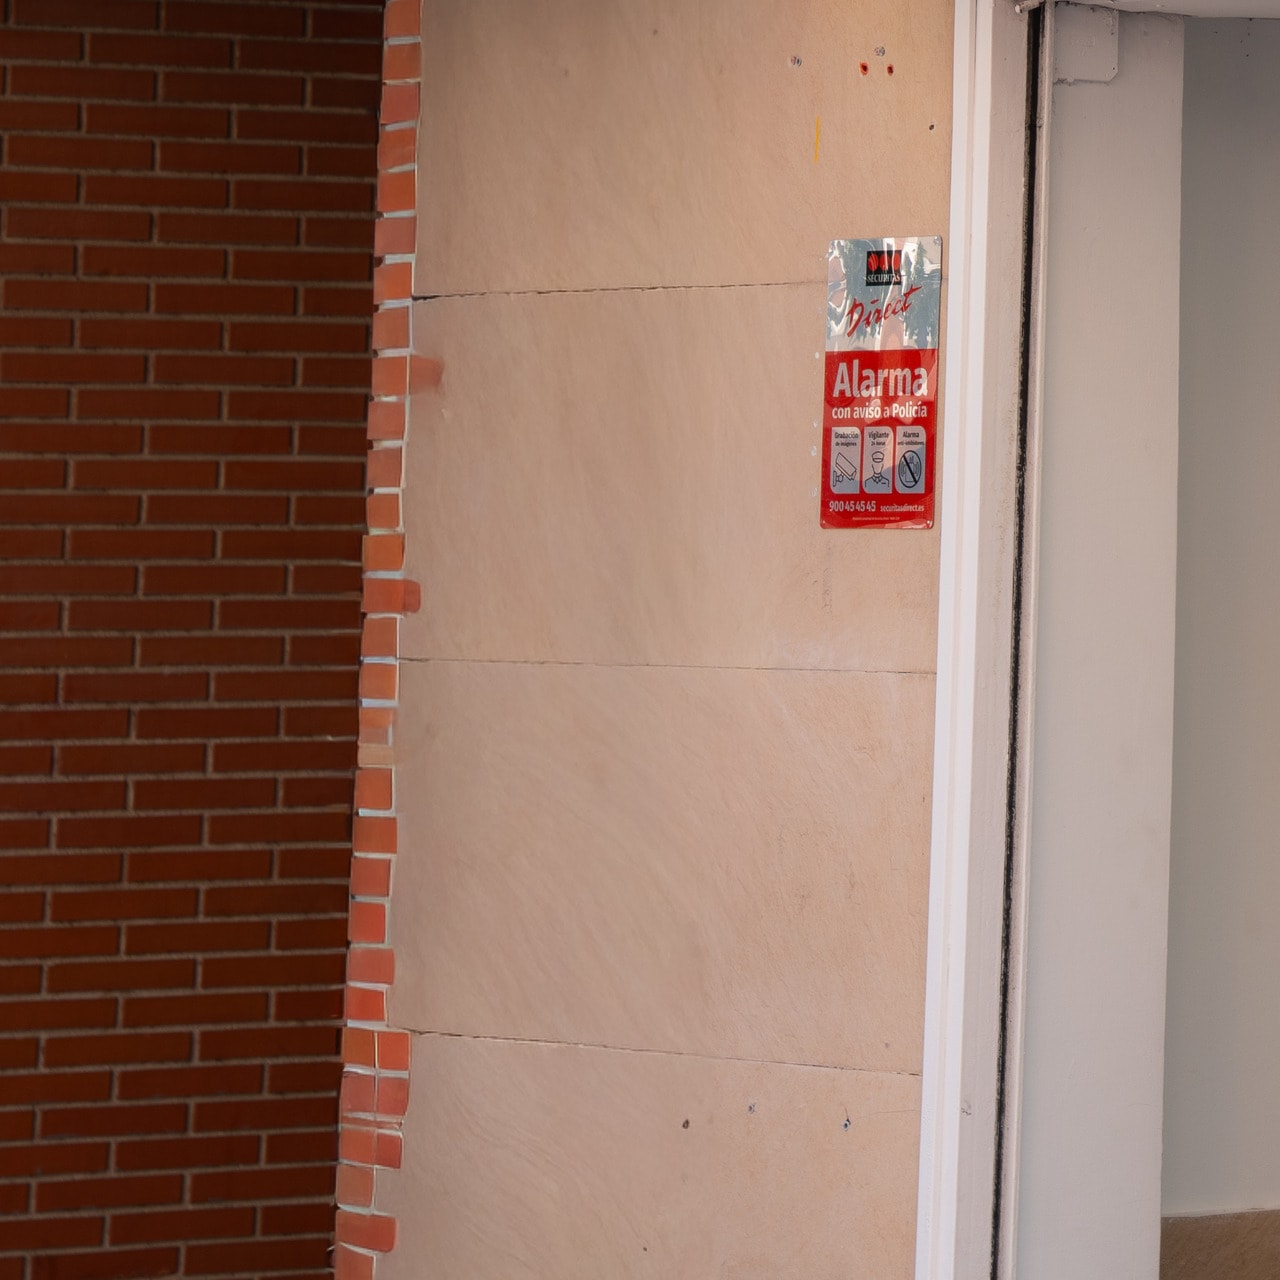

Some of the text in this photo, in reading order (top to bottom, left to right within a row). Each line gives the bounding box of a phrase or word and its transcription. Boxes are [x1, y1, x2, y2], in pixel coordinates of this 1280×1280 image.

[847, 285, 922, 337] Direct
[832, 358, 928, 398] Alarma
[832, 400, 928, 419] con aviso a Policía
[868, 431, 889, 440] Vigilante
[829, 500, 876, 512] 900 45 45 45
